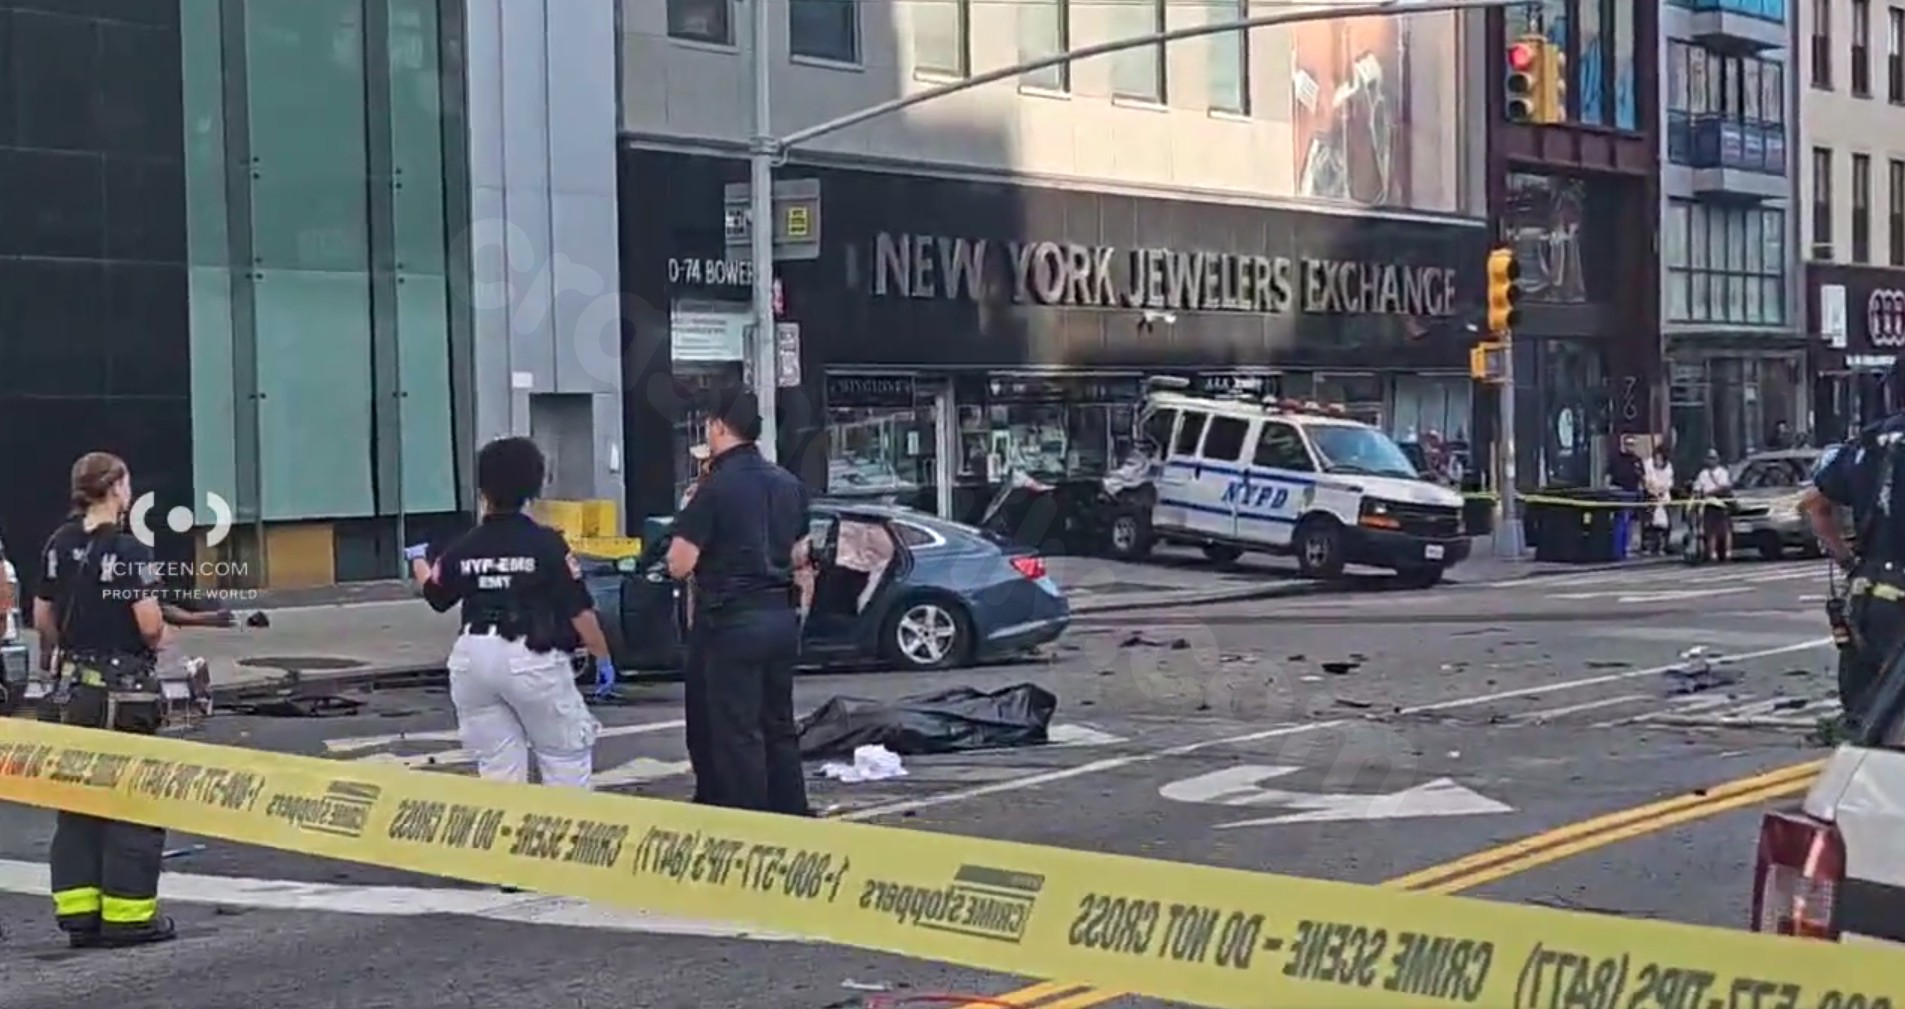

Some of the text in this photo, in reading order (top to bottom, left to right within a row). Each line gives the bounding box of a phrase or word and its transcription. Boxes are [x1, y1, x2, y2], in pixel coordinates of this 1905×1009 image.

[705, 260, 753, 286] BOWER
[875, 231, 1457, 315] NEW YORK JEWELERS EXCHANGE
[1220, 481, 1290, 510] NYPD
[478, 575, 512, 589] EMT
